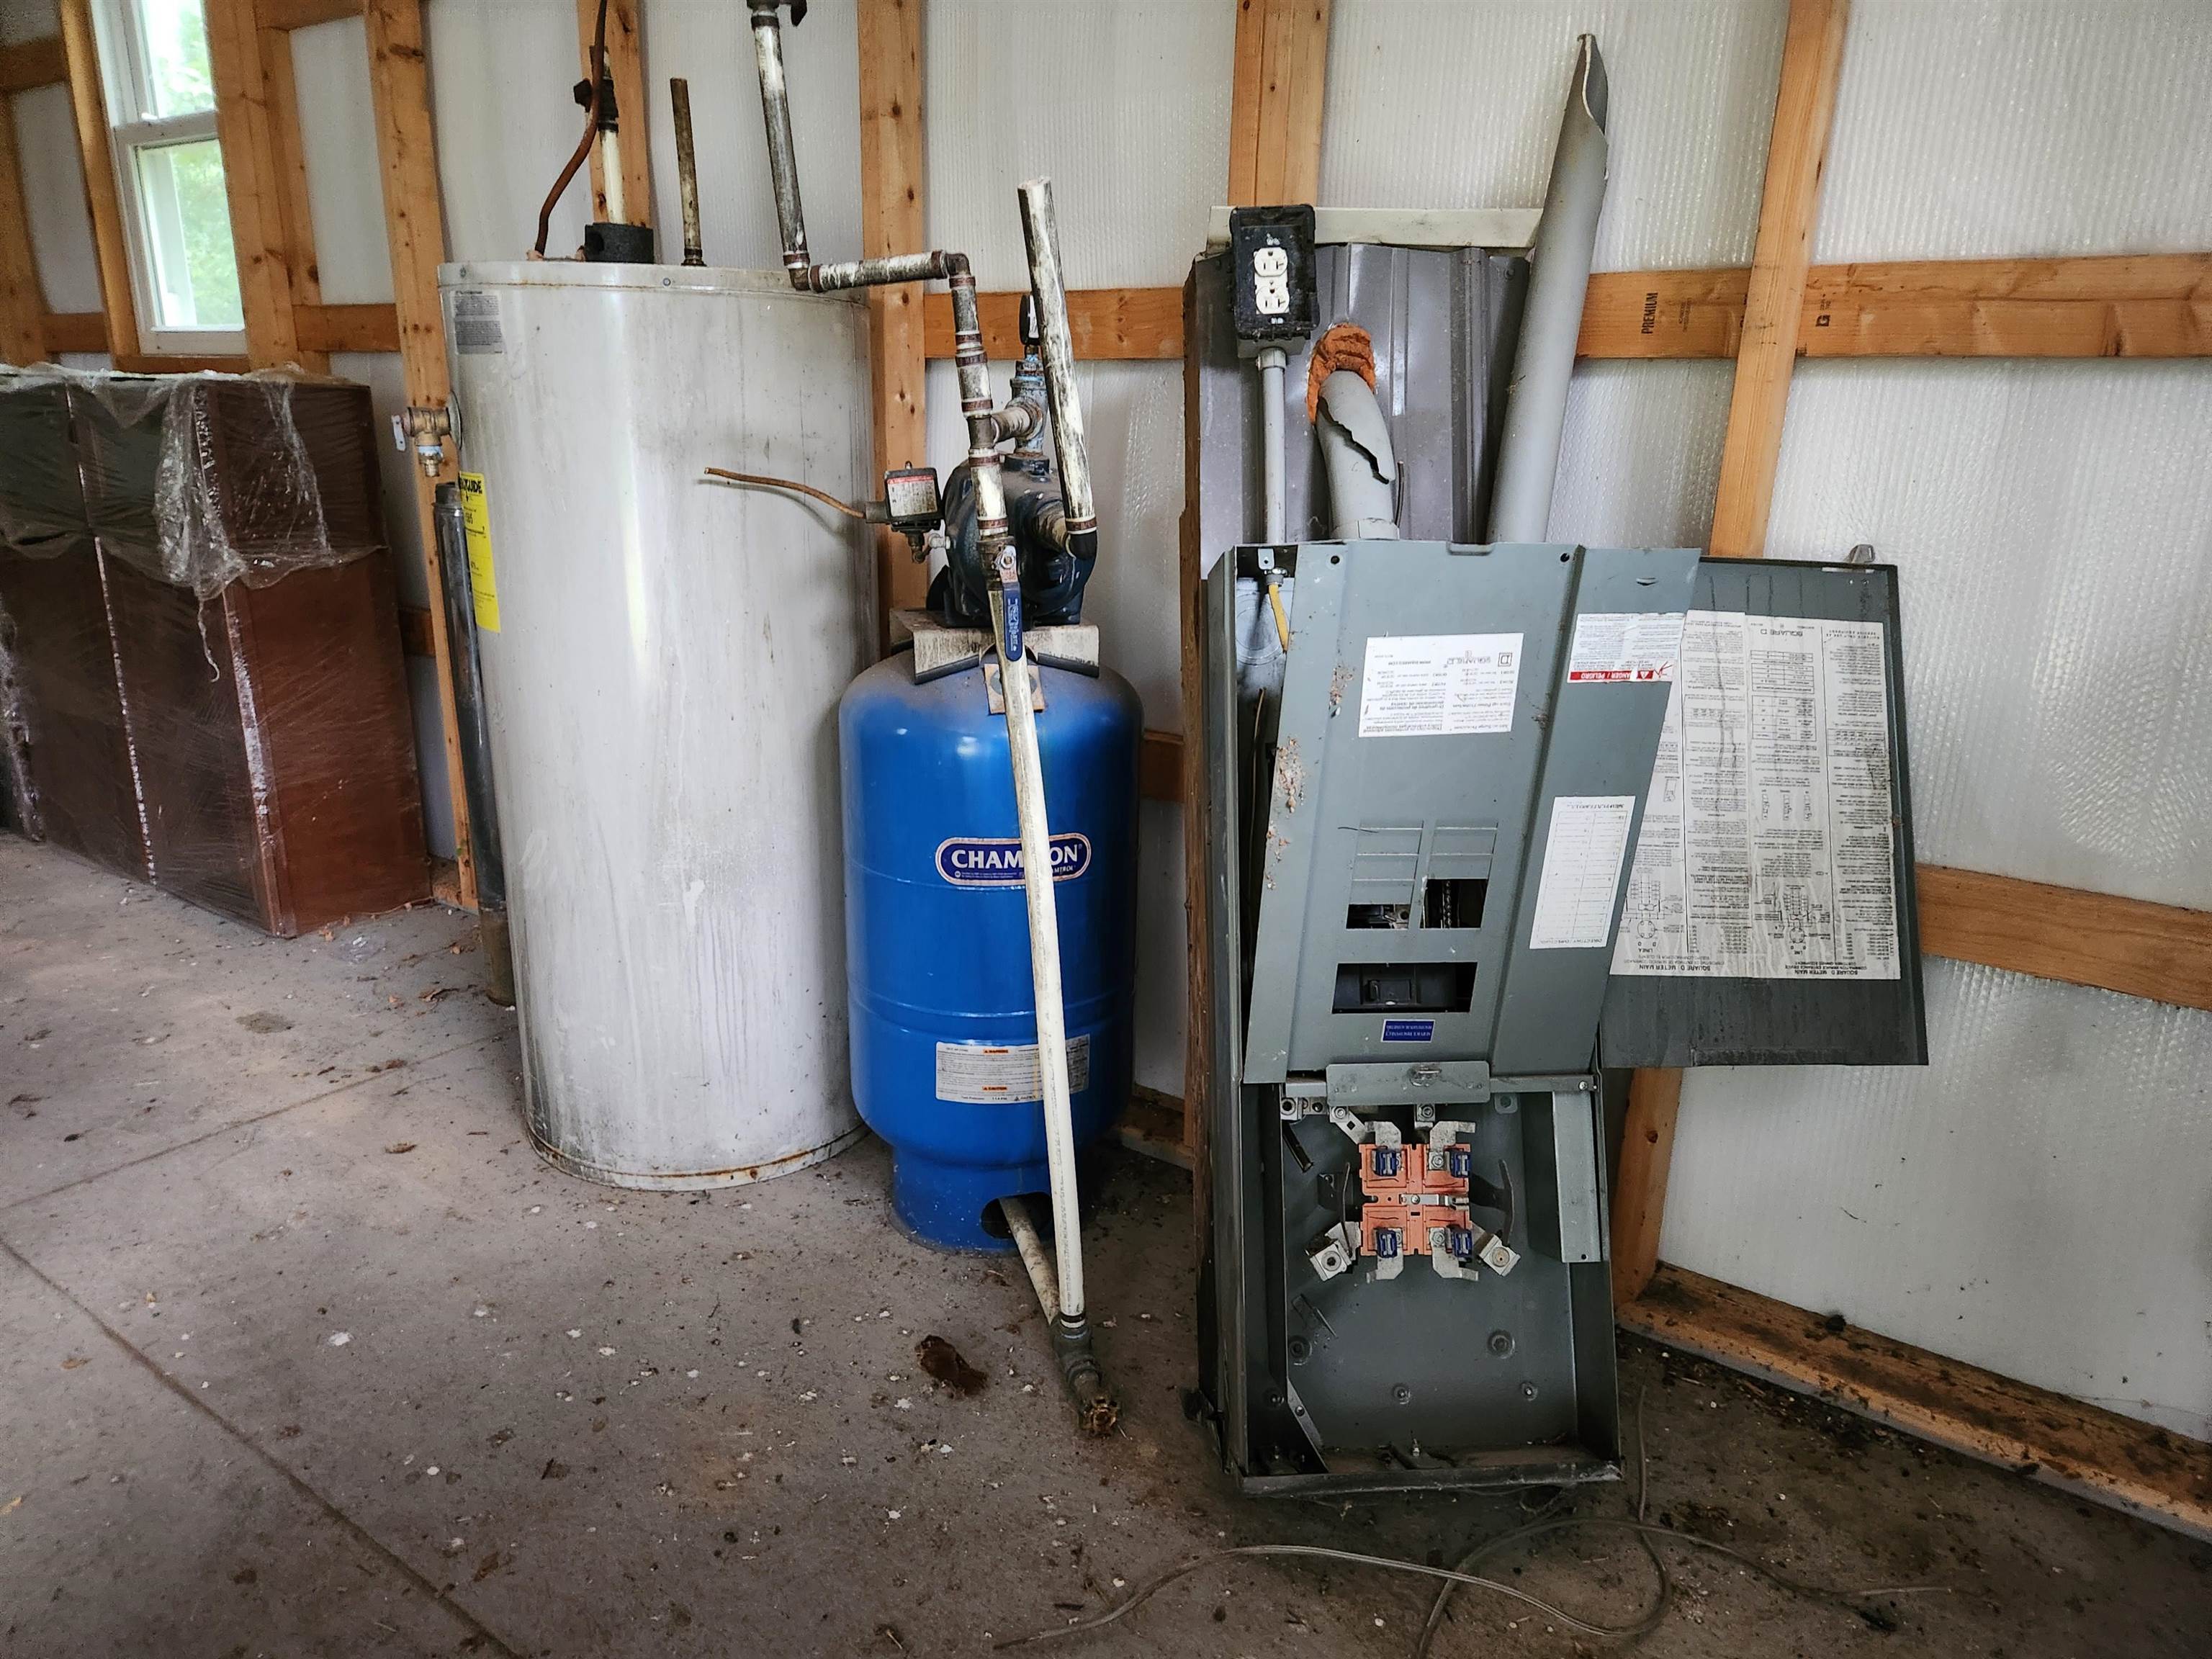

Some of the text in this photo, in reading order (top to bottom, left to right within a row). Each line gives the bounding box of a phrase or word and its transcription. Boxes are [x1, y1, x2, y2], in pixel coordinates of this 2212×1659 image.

[1641, 292, 1658, 335] PREMIUM
[1770, 629, 1803, 637] SQUARE
[950, 843, 1079, 869] CHAMON
